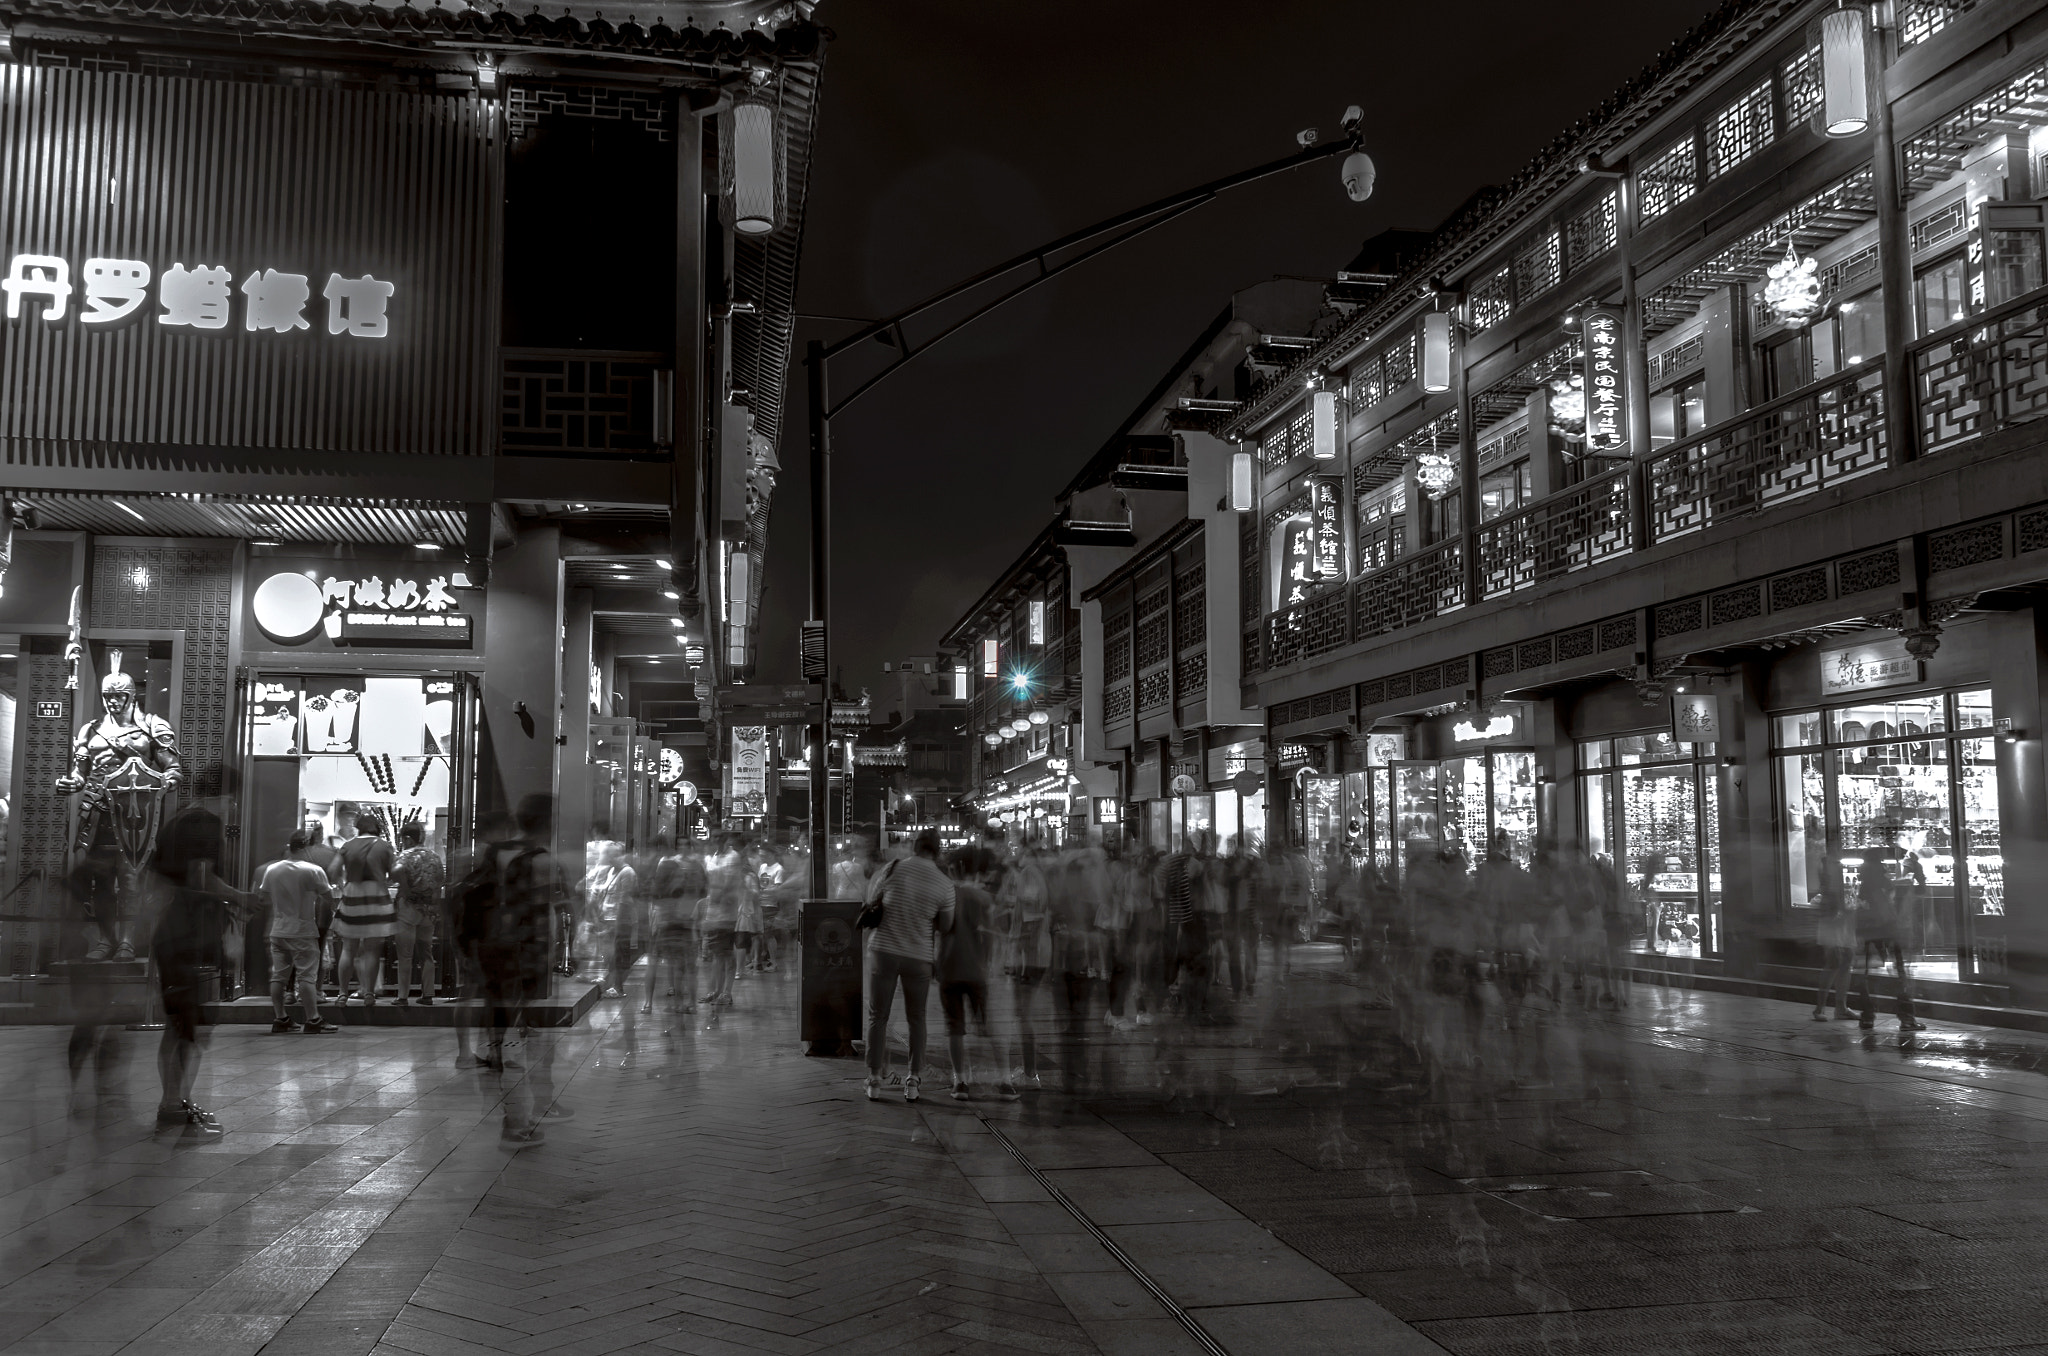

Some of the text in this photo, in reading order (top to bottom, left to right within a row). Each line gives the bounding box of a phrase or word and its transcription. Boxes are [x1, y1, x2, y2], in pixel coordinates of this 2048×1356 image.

[2, 253, 395, 338] 丹罗蜡像馆
[322, 576, 457, 613] 阿姨奶茶
[1869, 660, 1910, 676] 旅游超市
